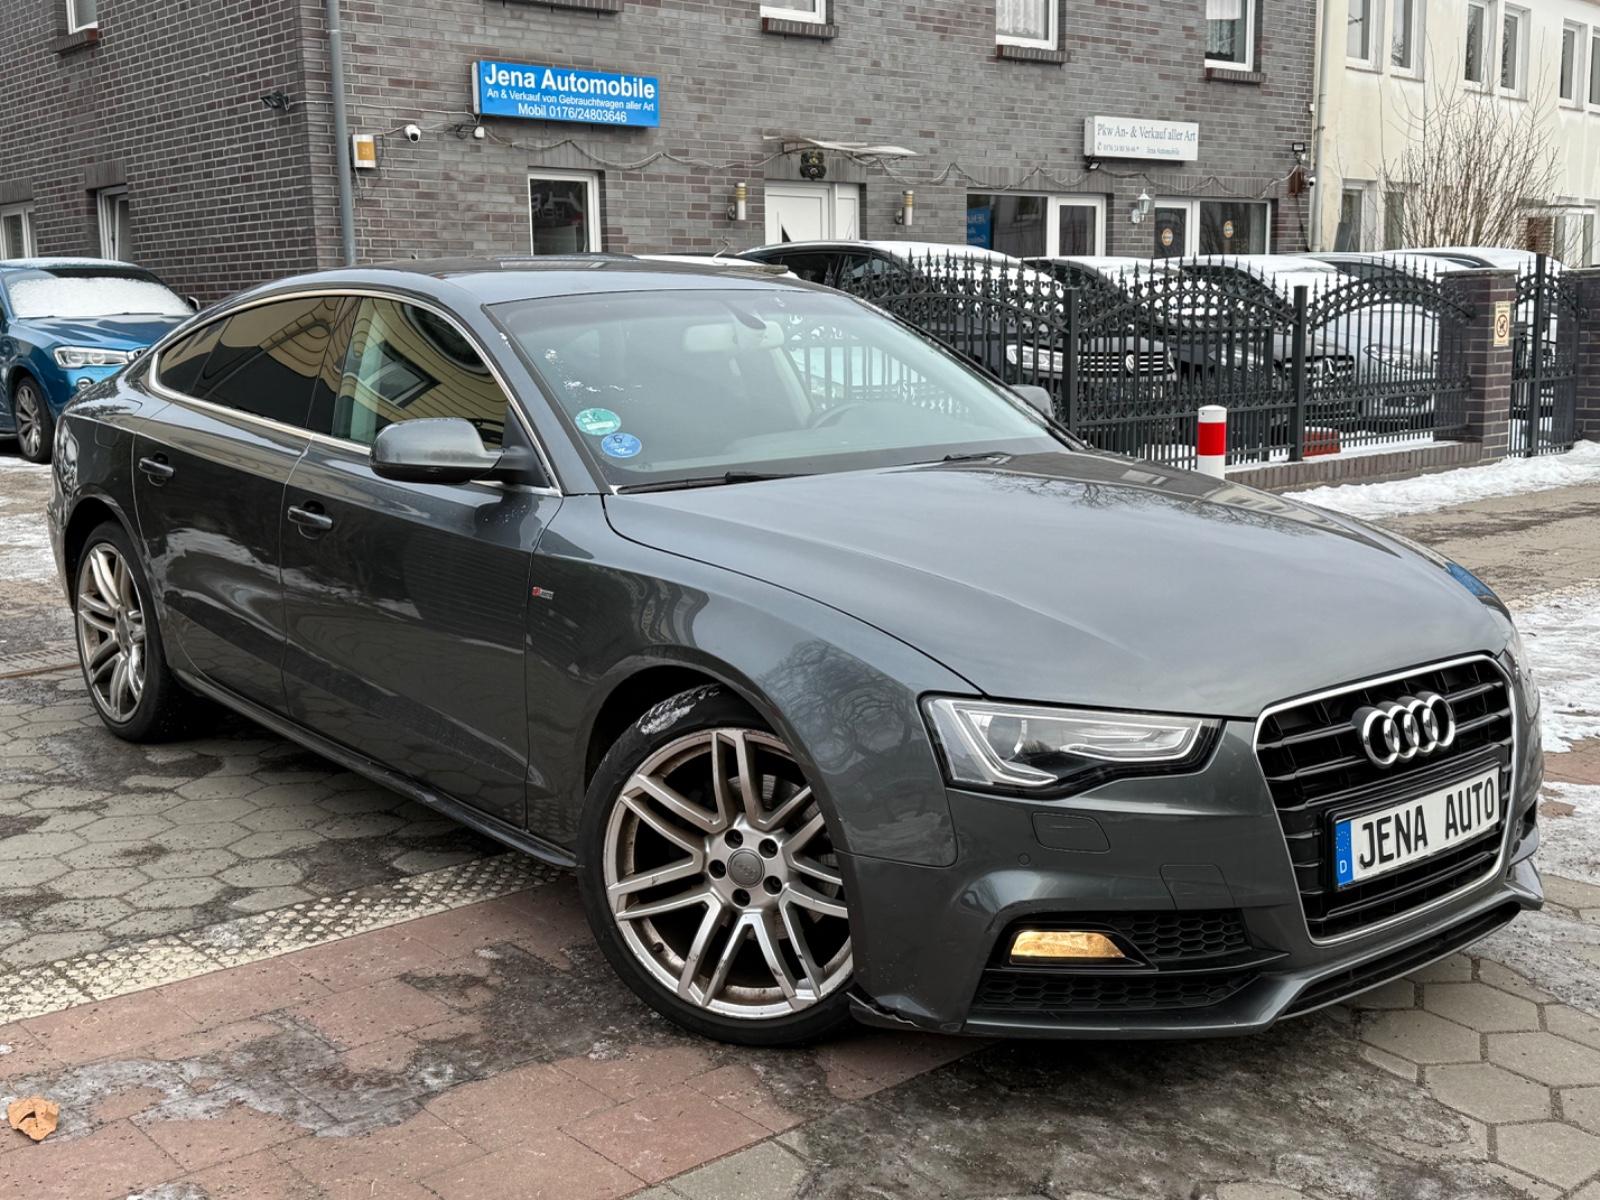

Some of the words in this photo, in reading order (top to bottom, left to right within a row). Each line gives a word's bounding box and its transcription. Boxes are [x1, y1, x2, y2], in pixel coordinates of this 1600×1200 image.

[484, 63, 536, 88] Jena
[541, 69, 655, 98] Automobile
[487, 88, 499, 98] An
[500, 89, 508, 99] &
[509, 90, 541, 102] Verkauf
[542, 95, 557, 104] von
[559, 94, 624, 109] Gebrauchtwagen
[626, 100, 642, 110] aller
[643, 101, 655, 111] Art
[518, 103, 546, 117] Mobil
[549, 105, 627, 123] 0176/24803646
[1098, 123, 1113, 137] Pkw
[1114, 126, 1129, 138] An-
[1130, 126, 1138, 138] &
[1139, 126, 1167, 140] Verkauf
[1168, 128, 1183, 141] aller
[1184, 130, 1196, 142] Art
[1360, 805, 1428, 869] JENA
[1446, 777, 1494, 840] AUTO
[1339, 860, 1348, 874] D
